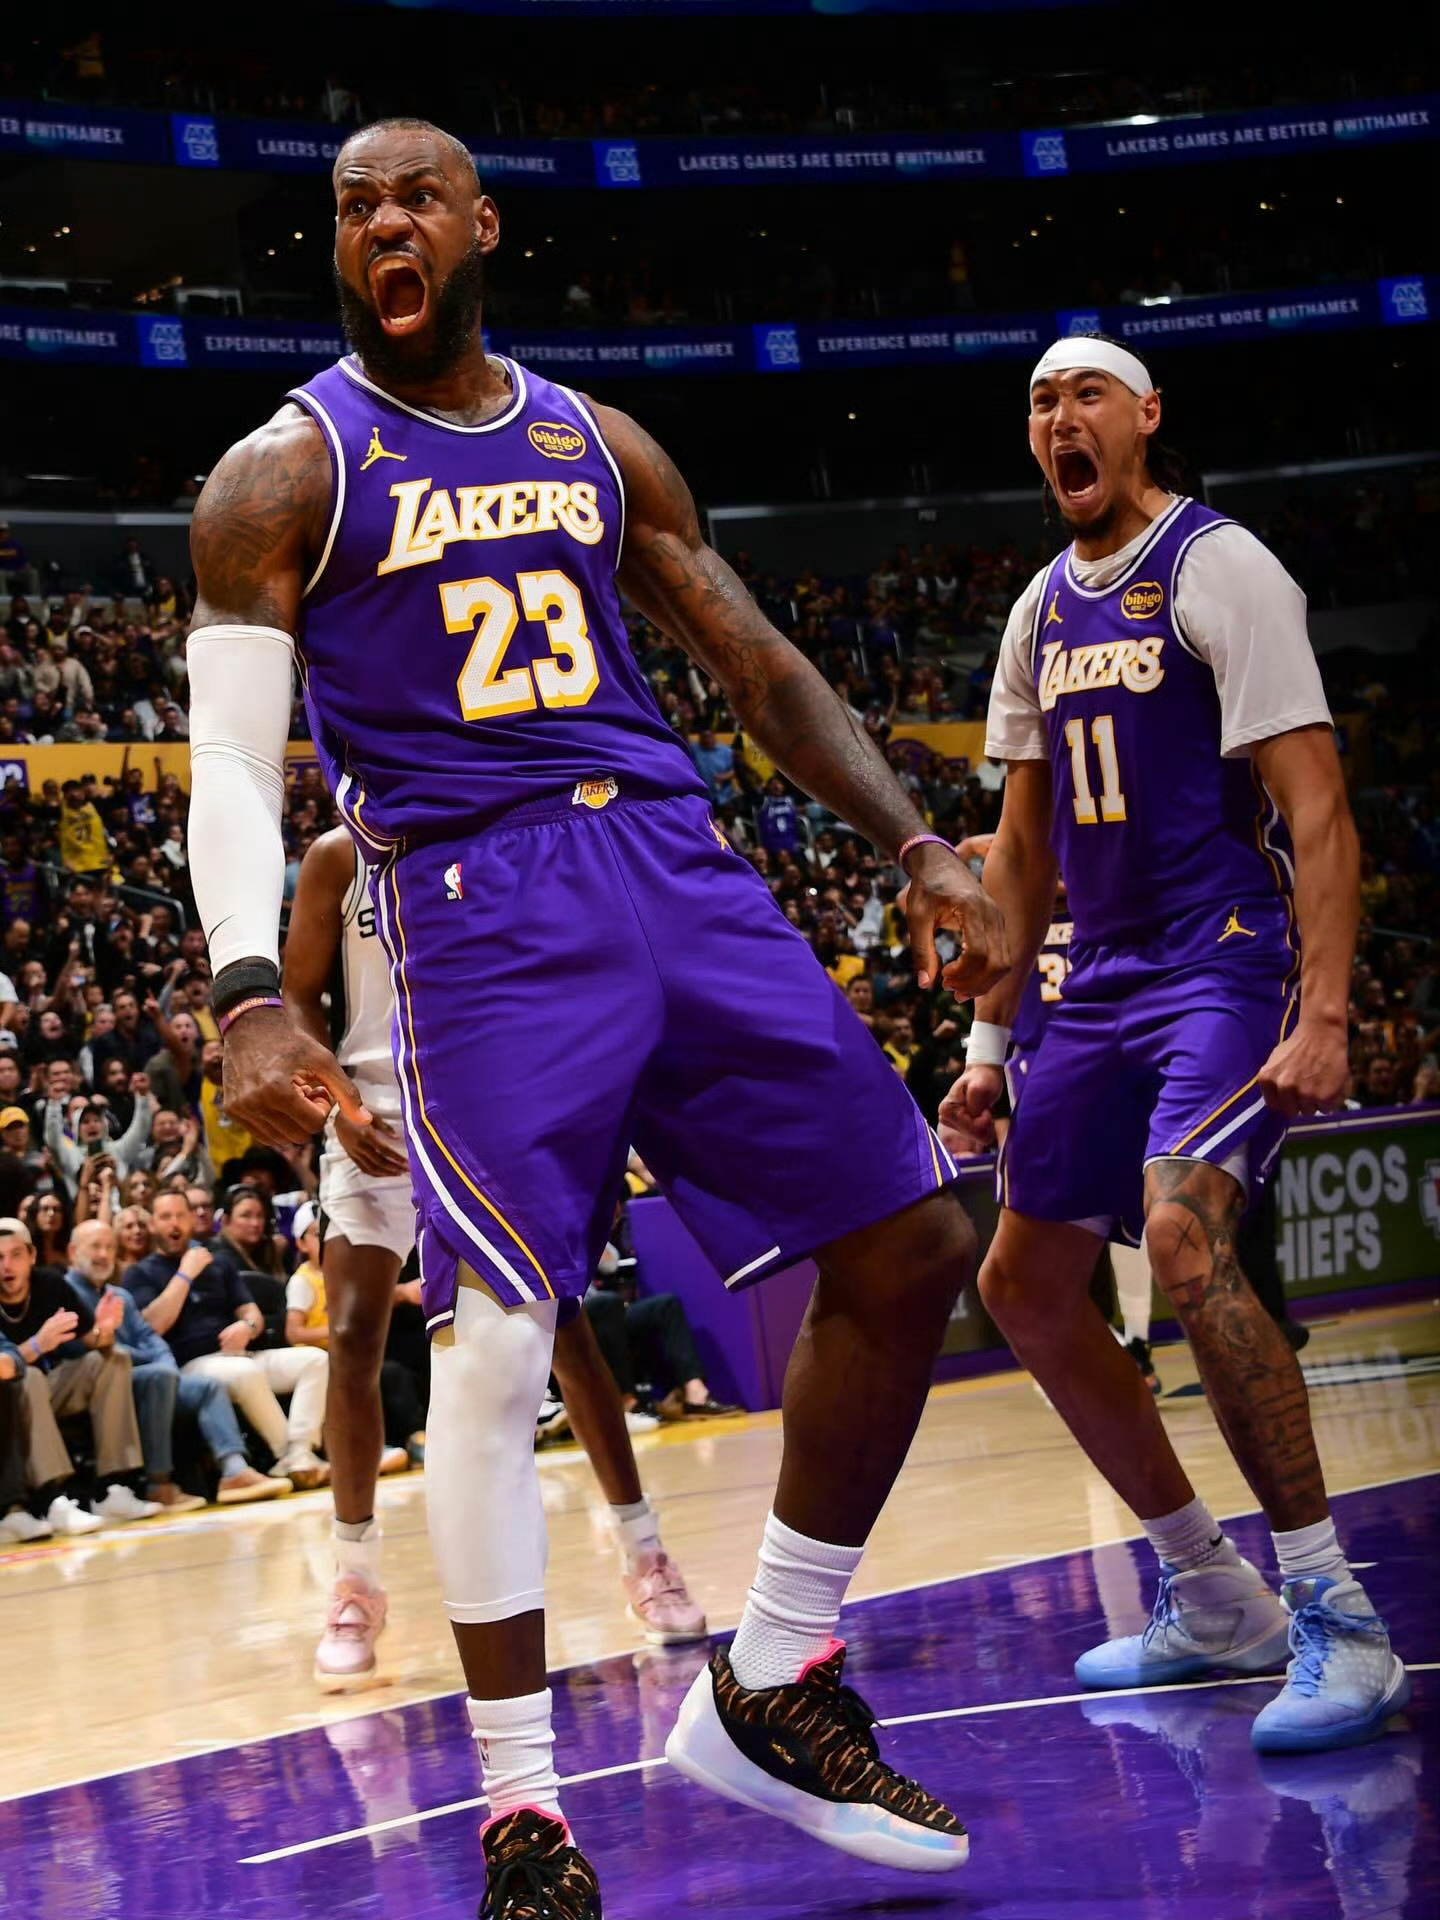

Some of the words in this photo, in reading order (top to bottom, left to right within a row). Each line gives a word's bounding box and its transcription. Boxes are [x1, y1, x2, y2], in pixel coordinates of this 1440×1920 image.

[1106, 136, 1169, 156] LAKERS
[1173, 132, 1229, 149] GAMES
[1233, 127, 1265, 143] ARE
[1268, 121, 1328, 140] BETTER
[1333, 111, 1430, 133] #WITHAMEX
[257, 140, 318, 157] LAKERS
[679, 155, 740, 171] LAKERS
[743, 154, 797, 169] GAMES
[801, 153, 831, 168] ARE
[834, 152, 891, 167] BETTER
[1123, 314, 1216, 336] EXPERIENCE
[1220, 308, 1263, 325] MORE
[206, 336, 296, 353] EXPERIENCE
[301, 339, 341, 355] MORE
[511, 346, 593, 361] EXPERIENCE
[598, 346, 640, 361] MORE
[818, 333, 905, 352] EXPERIENCE
[910, 332, 949, 348] MORE
[531, 430, 582, 451] bibigo
[377, 477, 605, 576] LAKERS
[1125, 592, 1161, 608] bibigo
[438, 569, 600, 722] 23
[1038, 637, 1165, 712] LAKERS
[1065, 714, 1127, 825] 11
[1274, 1144, 1408, 1219] NCOS
